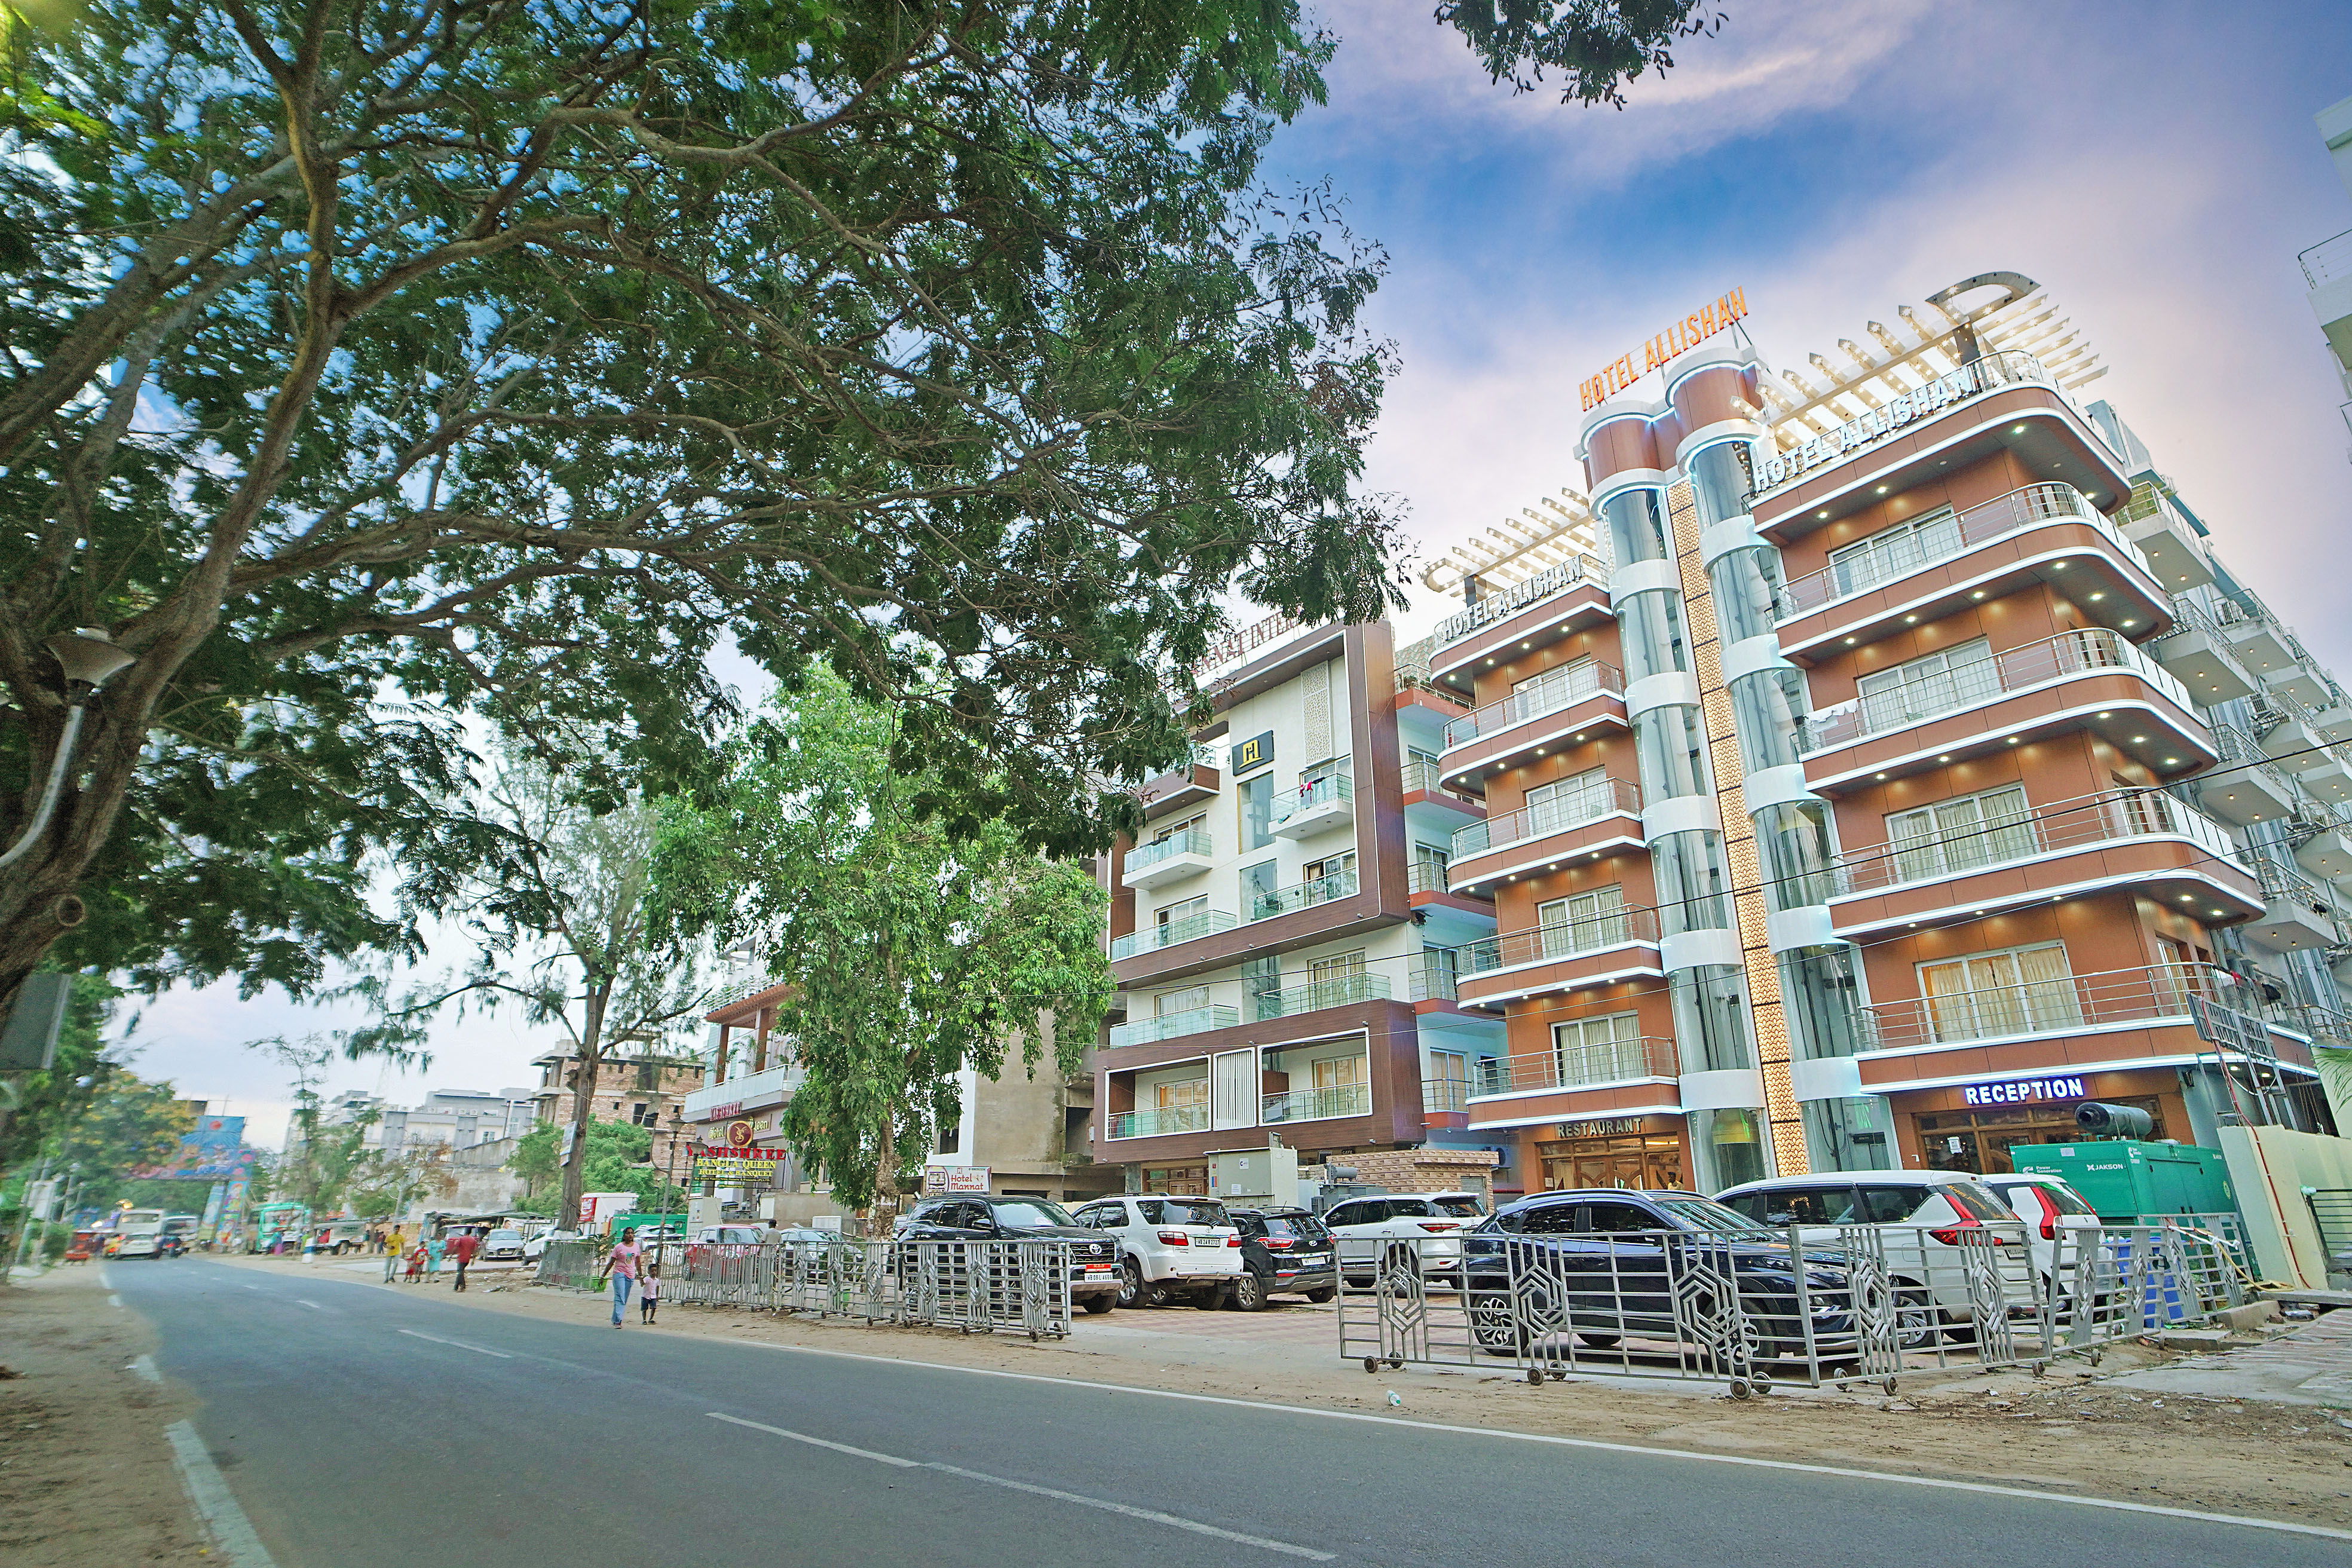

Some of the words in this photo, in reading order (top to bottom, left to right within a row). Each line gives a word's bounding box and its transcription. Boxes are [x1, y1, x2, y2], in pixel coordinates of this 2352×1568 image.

[1579, 353, 1639, 412] HOTEL
[1645, 285, 1748, 373] ALLISHAN
[1753, 437, 1832, 492] HOTEL
[1839, 365, 1974, 452] ALLISHAN
[1441, 599, 1494, 641] HOTEL
[1498, 555, 1586, 615] ALLISHAN
[1965, 1077, 2084, 1104] RECEPTION
[1557, 1117, 1642, 1138] RESTAURANT
[696, 1158, 739, 1168] BANGLA
[742, 1160, 776, 1170] QUEEN
[951, 1173, 972, 1182] Hotel
